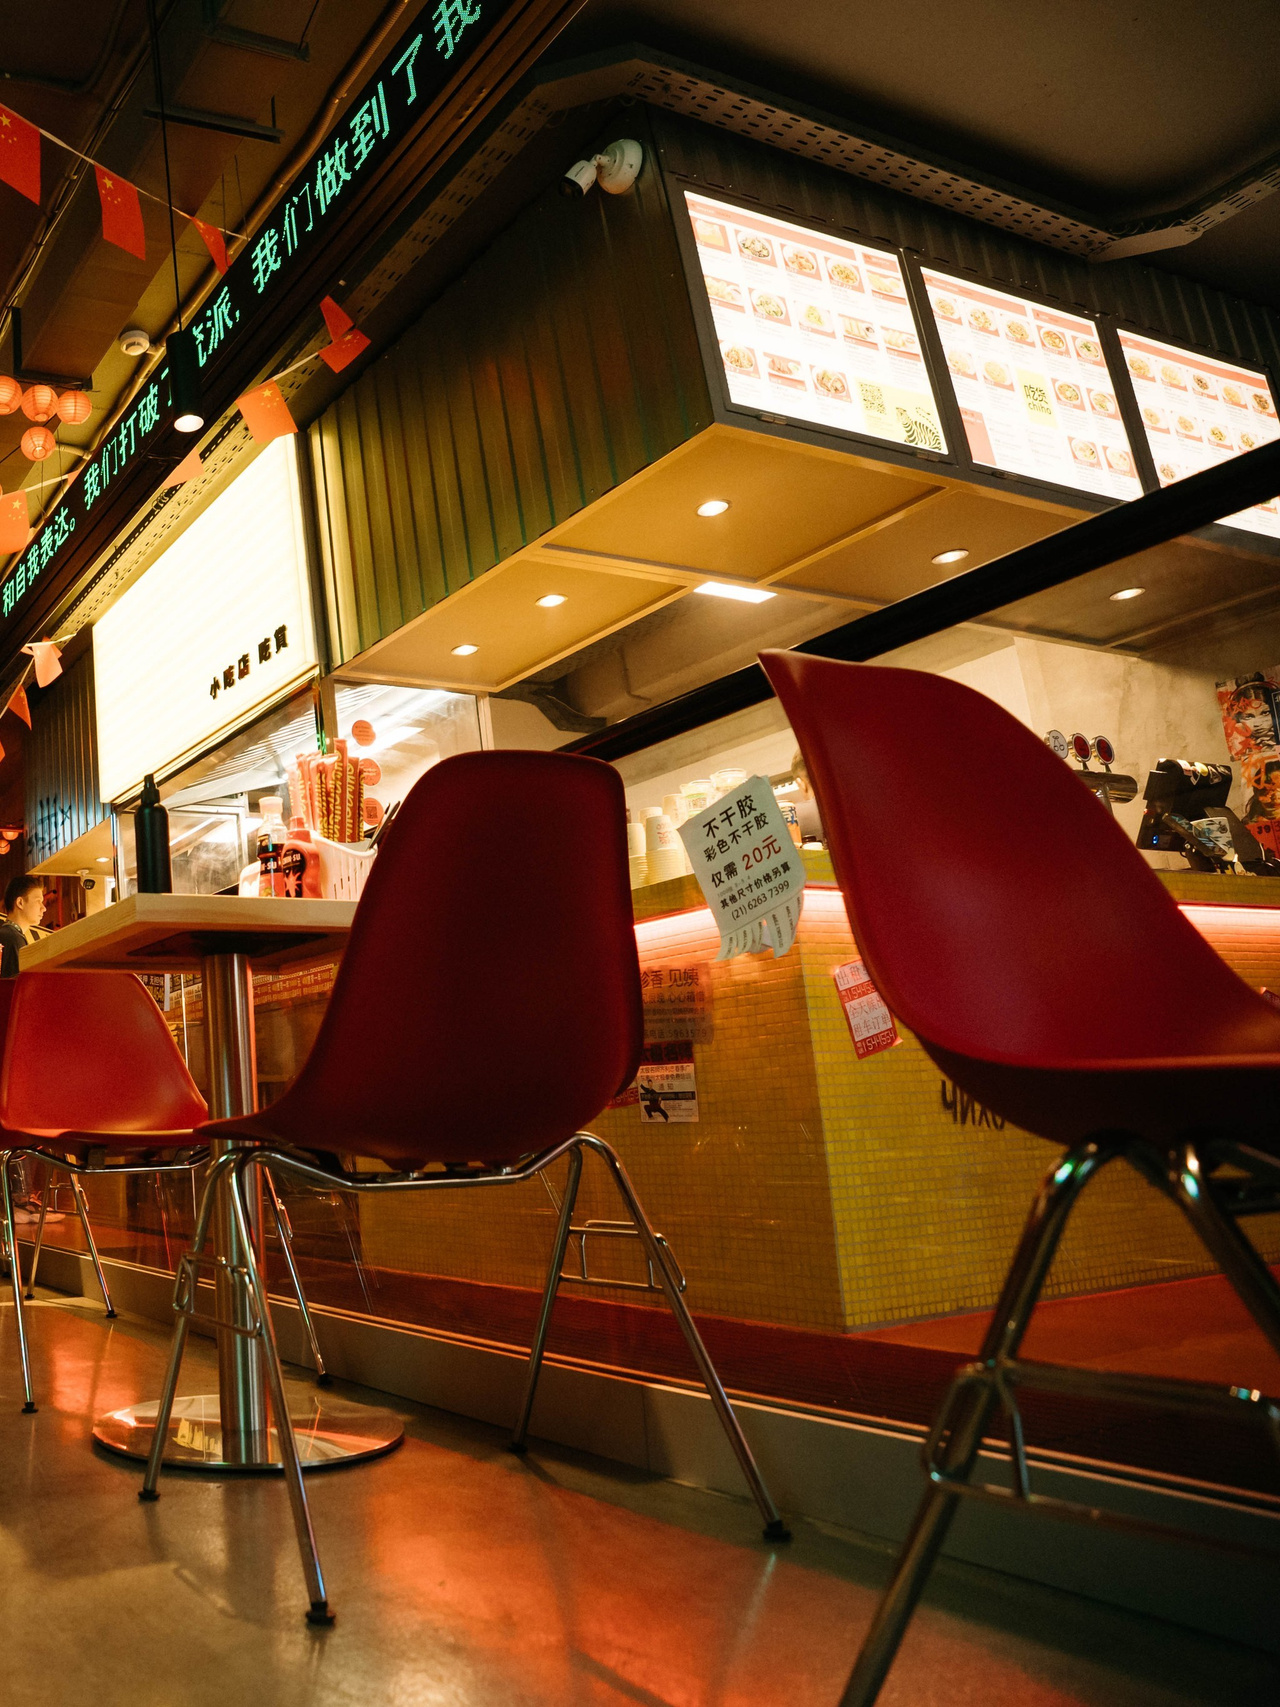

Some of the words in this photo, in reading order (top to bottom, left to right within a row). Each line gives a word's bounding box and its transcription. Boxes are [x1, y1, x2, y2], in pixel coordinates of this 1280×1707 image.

[1028, 401, 1052, 415] chiho
[209, 652, 250, 701] 小吃店
[702, 794, 758, 840] 不干胶
[703, 812, 770, 863] 彩色不干胶
[711, 861, 739, 889] 仅需
[742, 834, 782, 871] 20元
[720, 861, 792, 910] 其他尺寸价格另算
[731, 903, 748, 922] (21)
[747, 892, 768, 911] 6263
[769, 879, 790, 900] 7399
